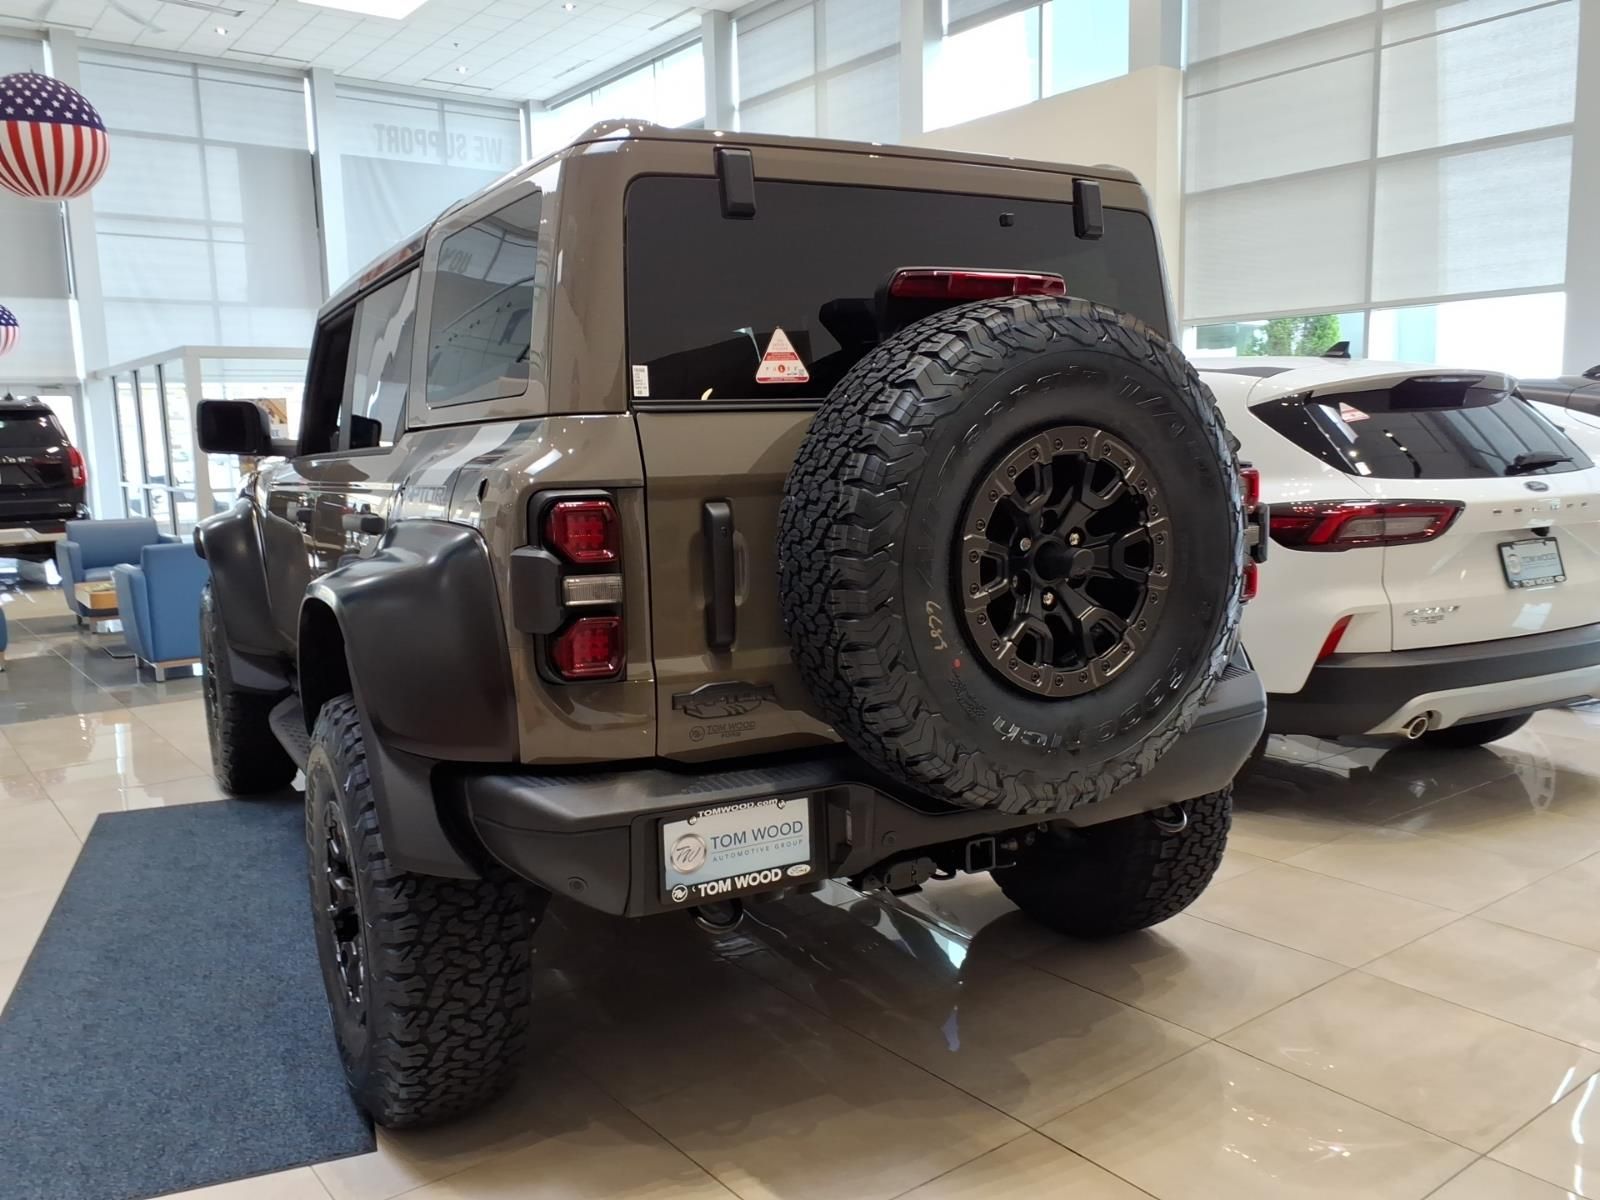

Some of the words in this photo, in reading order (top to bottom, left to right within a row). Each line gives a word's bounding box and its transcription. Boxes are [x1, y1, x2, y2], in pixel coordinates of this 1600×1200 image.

[697, 798, 778, 818] TOMWOOD.com
[710, 831, 747, 850] TOM
[751, 820, 804, 842] WOOD
[712, 845, 770, 863] AUTOMOTIVE
[774, 838, 804, 851] GROUP
[698, 879, 732, 898] TOM
[735, 868, 782, 889] WOOD
